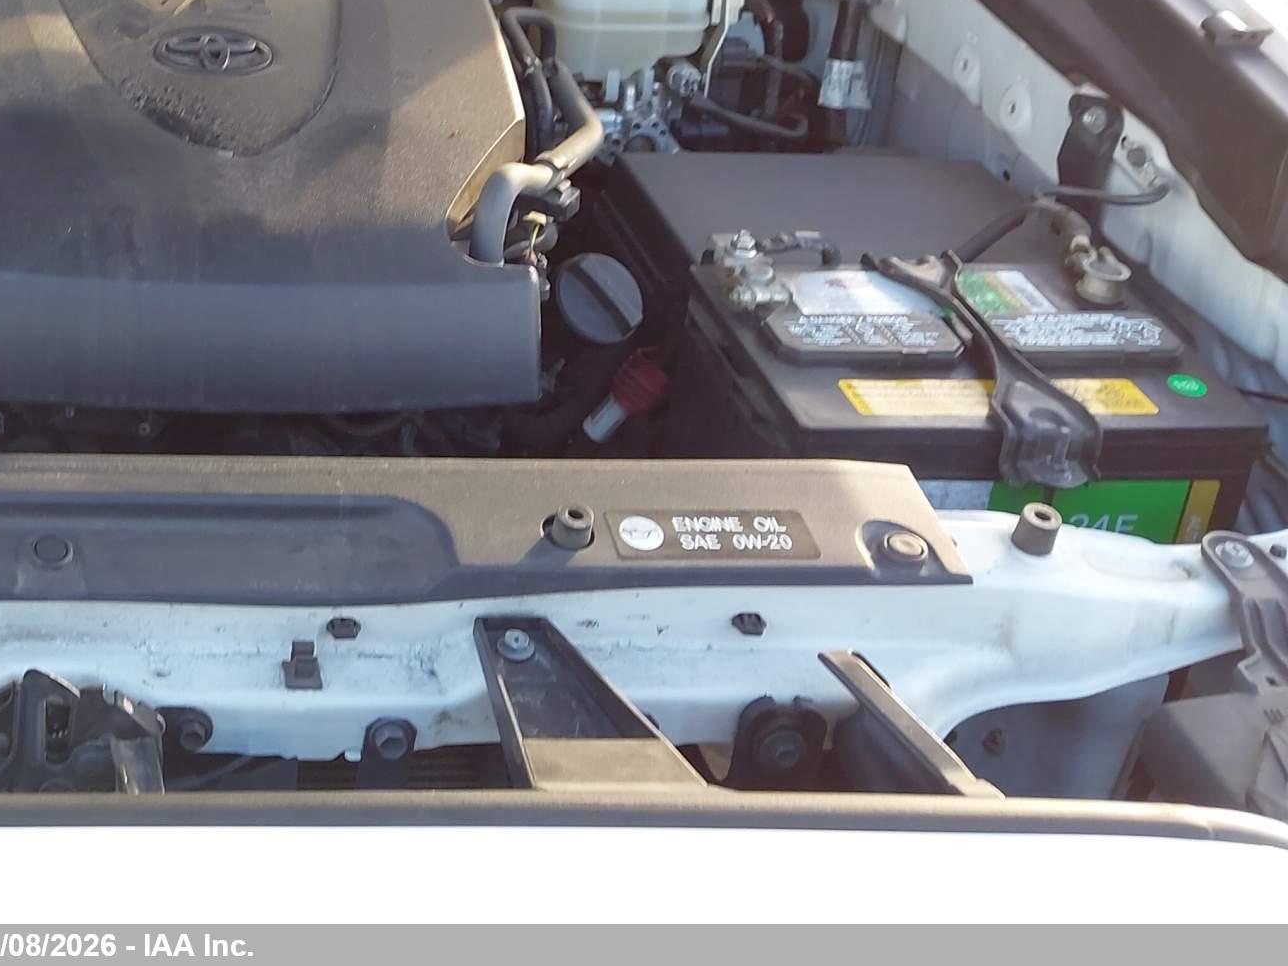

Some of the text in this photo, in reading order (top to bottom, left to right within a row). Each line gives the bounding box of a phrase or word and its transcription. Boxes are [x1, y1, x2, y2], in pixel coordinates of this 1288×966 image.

[671, 516, 788, 533] ENGINE OIL
[679, 533, 793, 551] SAE 0W-20
